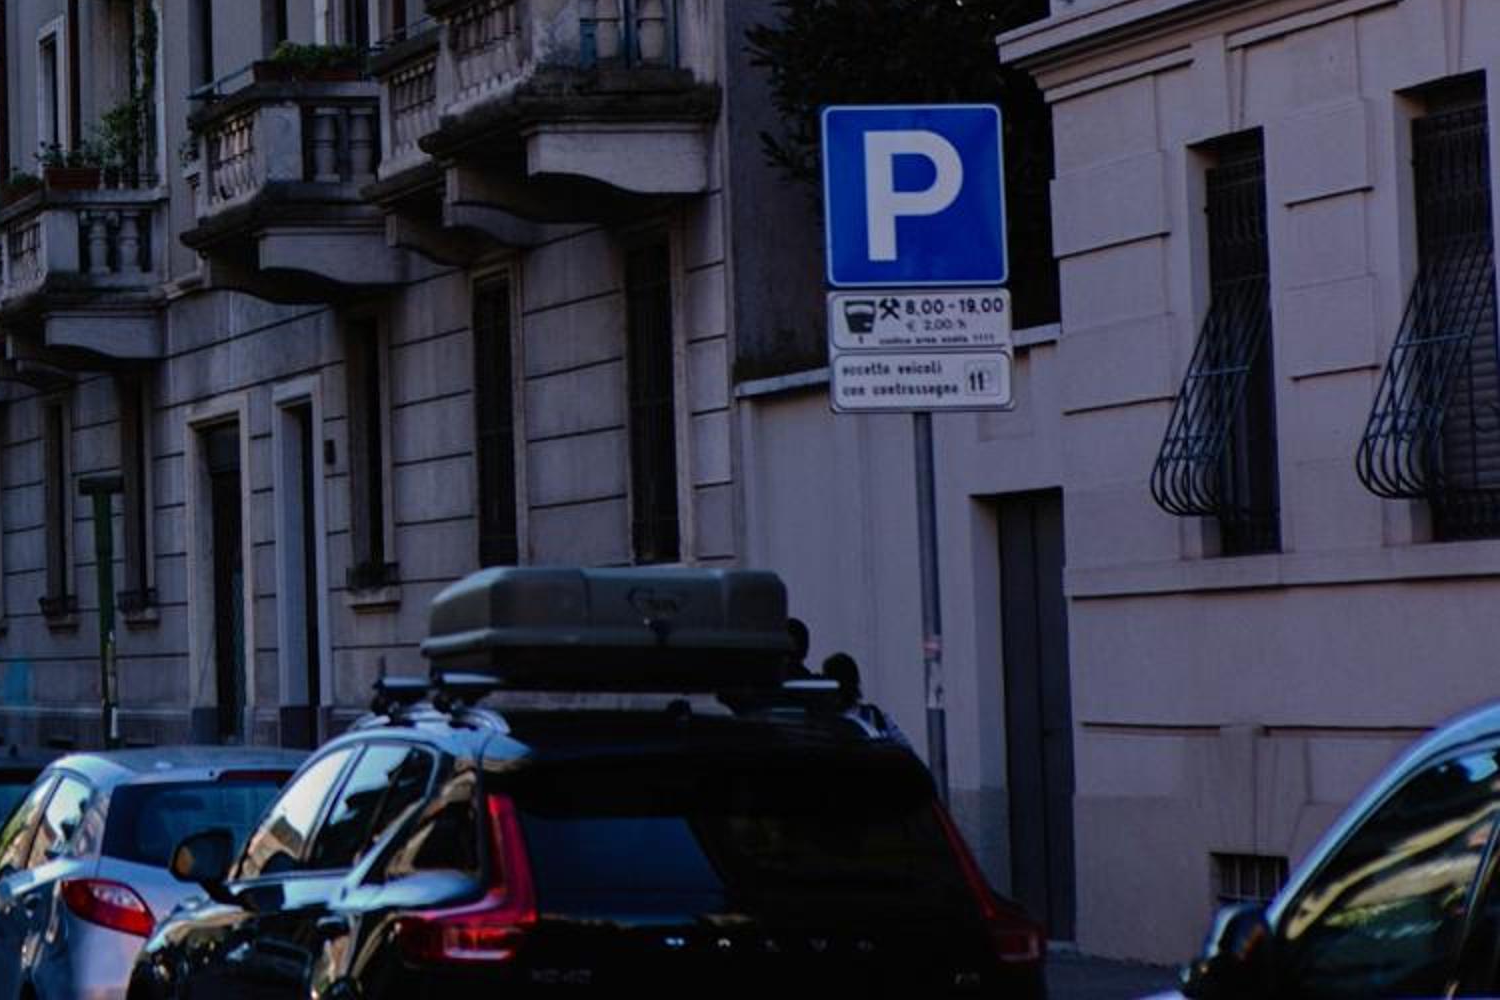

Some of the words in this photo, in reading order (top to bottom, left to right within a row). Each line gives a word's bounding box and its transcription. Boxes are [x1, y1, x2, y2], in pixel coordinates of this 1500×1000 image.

[864, 130, 964, 262] P
[842, 361, 891, 376] eccetto
[898, 359, 942, 375] veicoli
[842, 385, 866, 396] con
[872, 382, 959, 399] contrassegno
